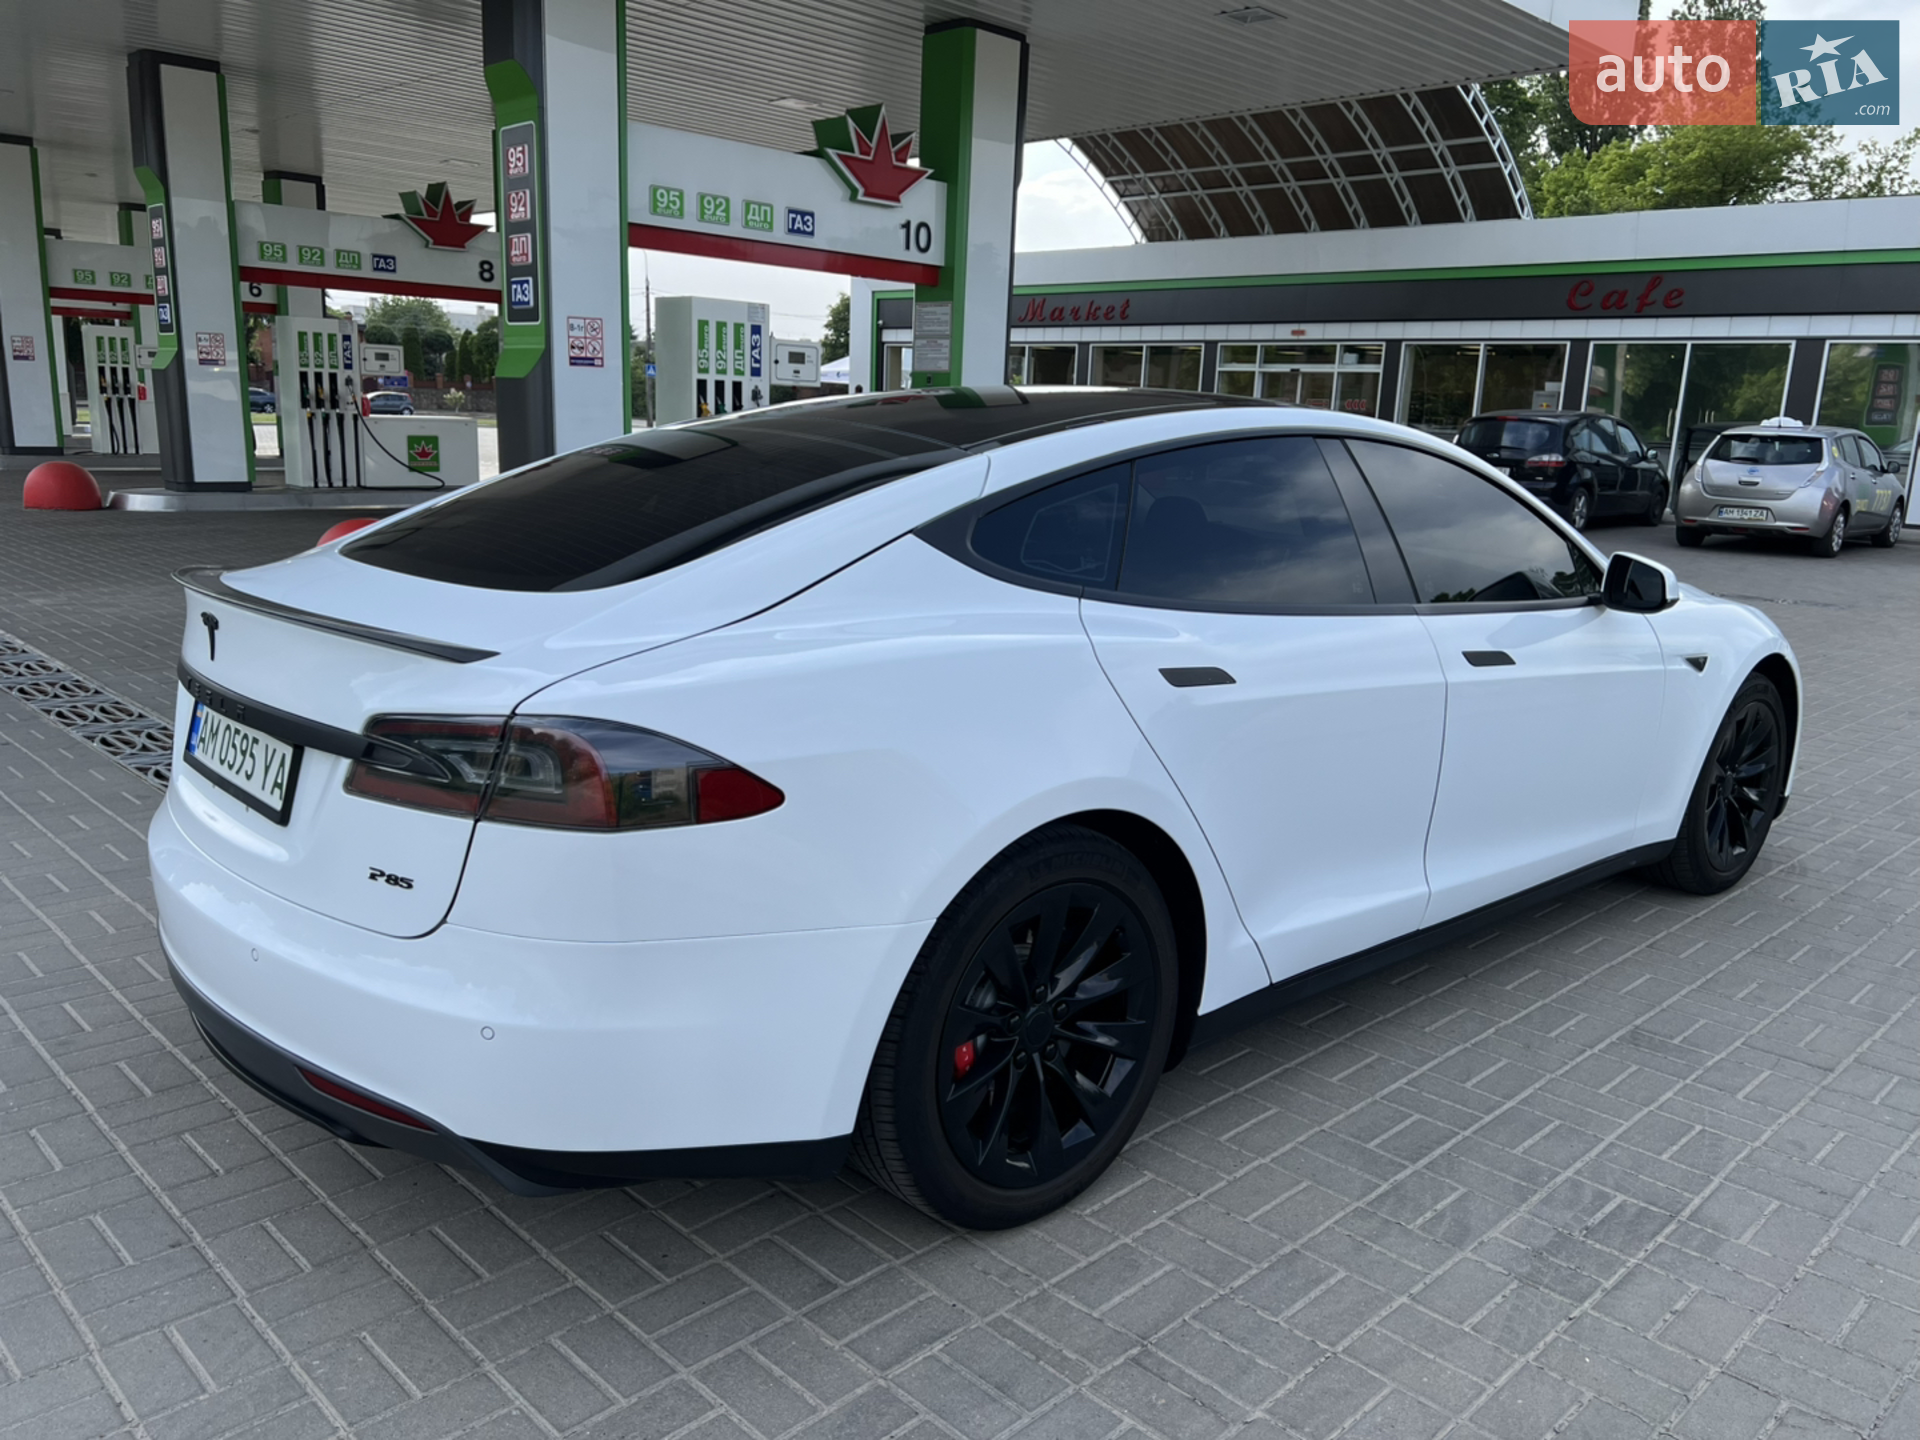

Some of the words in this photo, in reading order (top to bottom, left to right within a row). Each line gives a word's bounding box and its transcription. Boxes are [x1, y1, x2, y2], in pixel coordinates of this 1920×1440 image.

[508, 148, 524, 168] 95
[510, 192, 525, 212] 92
[656, 189, 680, 210] 95
[703, 196, 726, 217] 92
[656, 206, 680, 216] euro
[704, 213, 726, 223] euro
[748, 219, 770, 229] euro
[747, 204, 771, 222] ДП
[788, 213, 813, 233] ГАЗ
[511, 236, 528, 257] ДП
[899, 219, 932, 254] 10
[263, 243, 283, 257] 95
[301, 247, 321, 260] 92
[338, 251, 358, 265] ДП
[372, 257, 395, 270] ГАЗ
[75, 269, 93, 281] 95
[112, 272, 128, 284] 92
[478, 260, 495, 283] 8
[249, 282, 262, 298] 6
[512, 284, 529, 302] ГАЗ
[1567, 274, 1685, 313] Cafe
[1017, 297, 1130, 323] Market
[752, 334, 761, 368] ГАЗ
[187, 675, 246, 721] TESLA
[197, 711, 222, 760] AM
[219, 723, 260, 781] 0595
[261, 743, 287, 801] YA
[368, 866, 414, 890] P85
